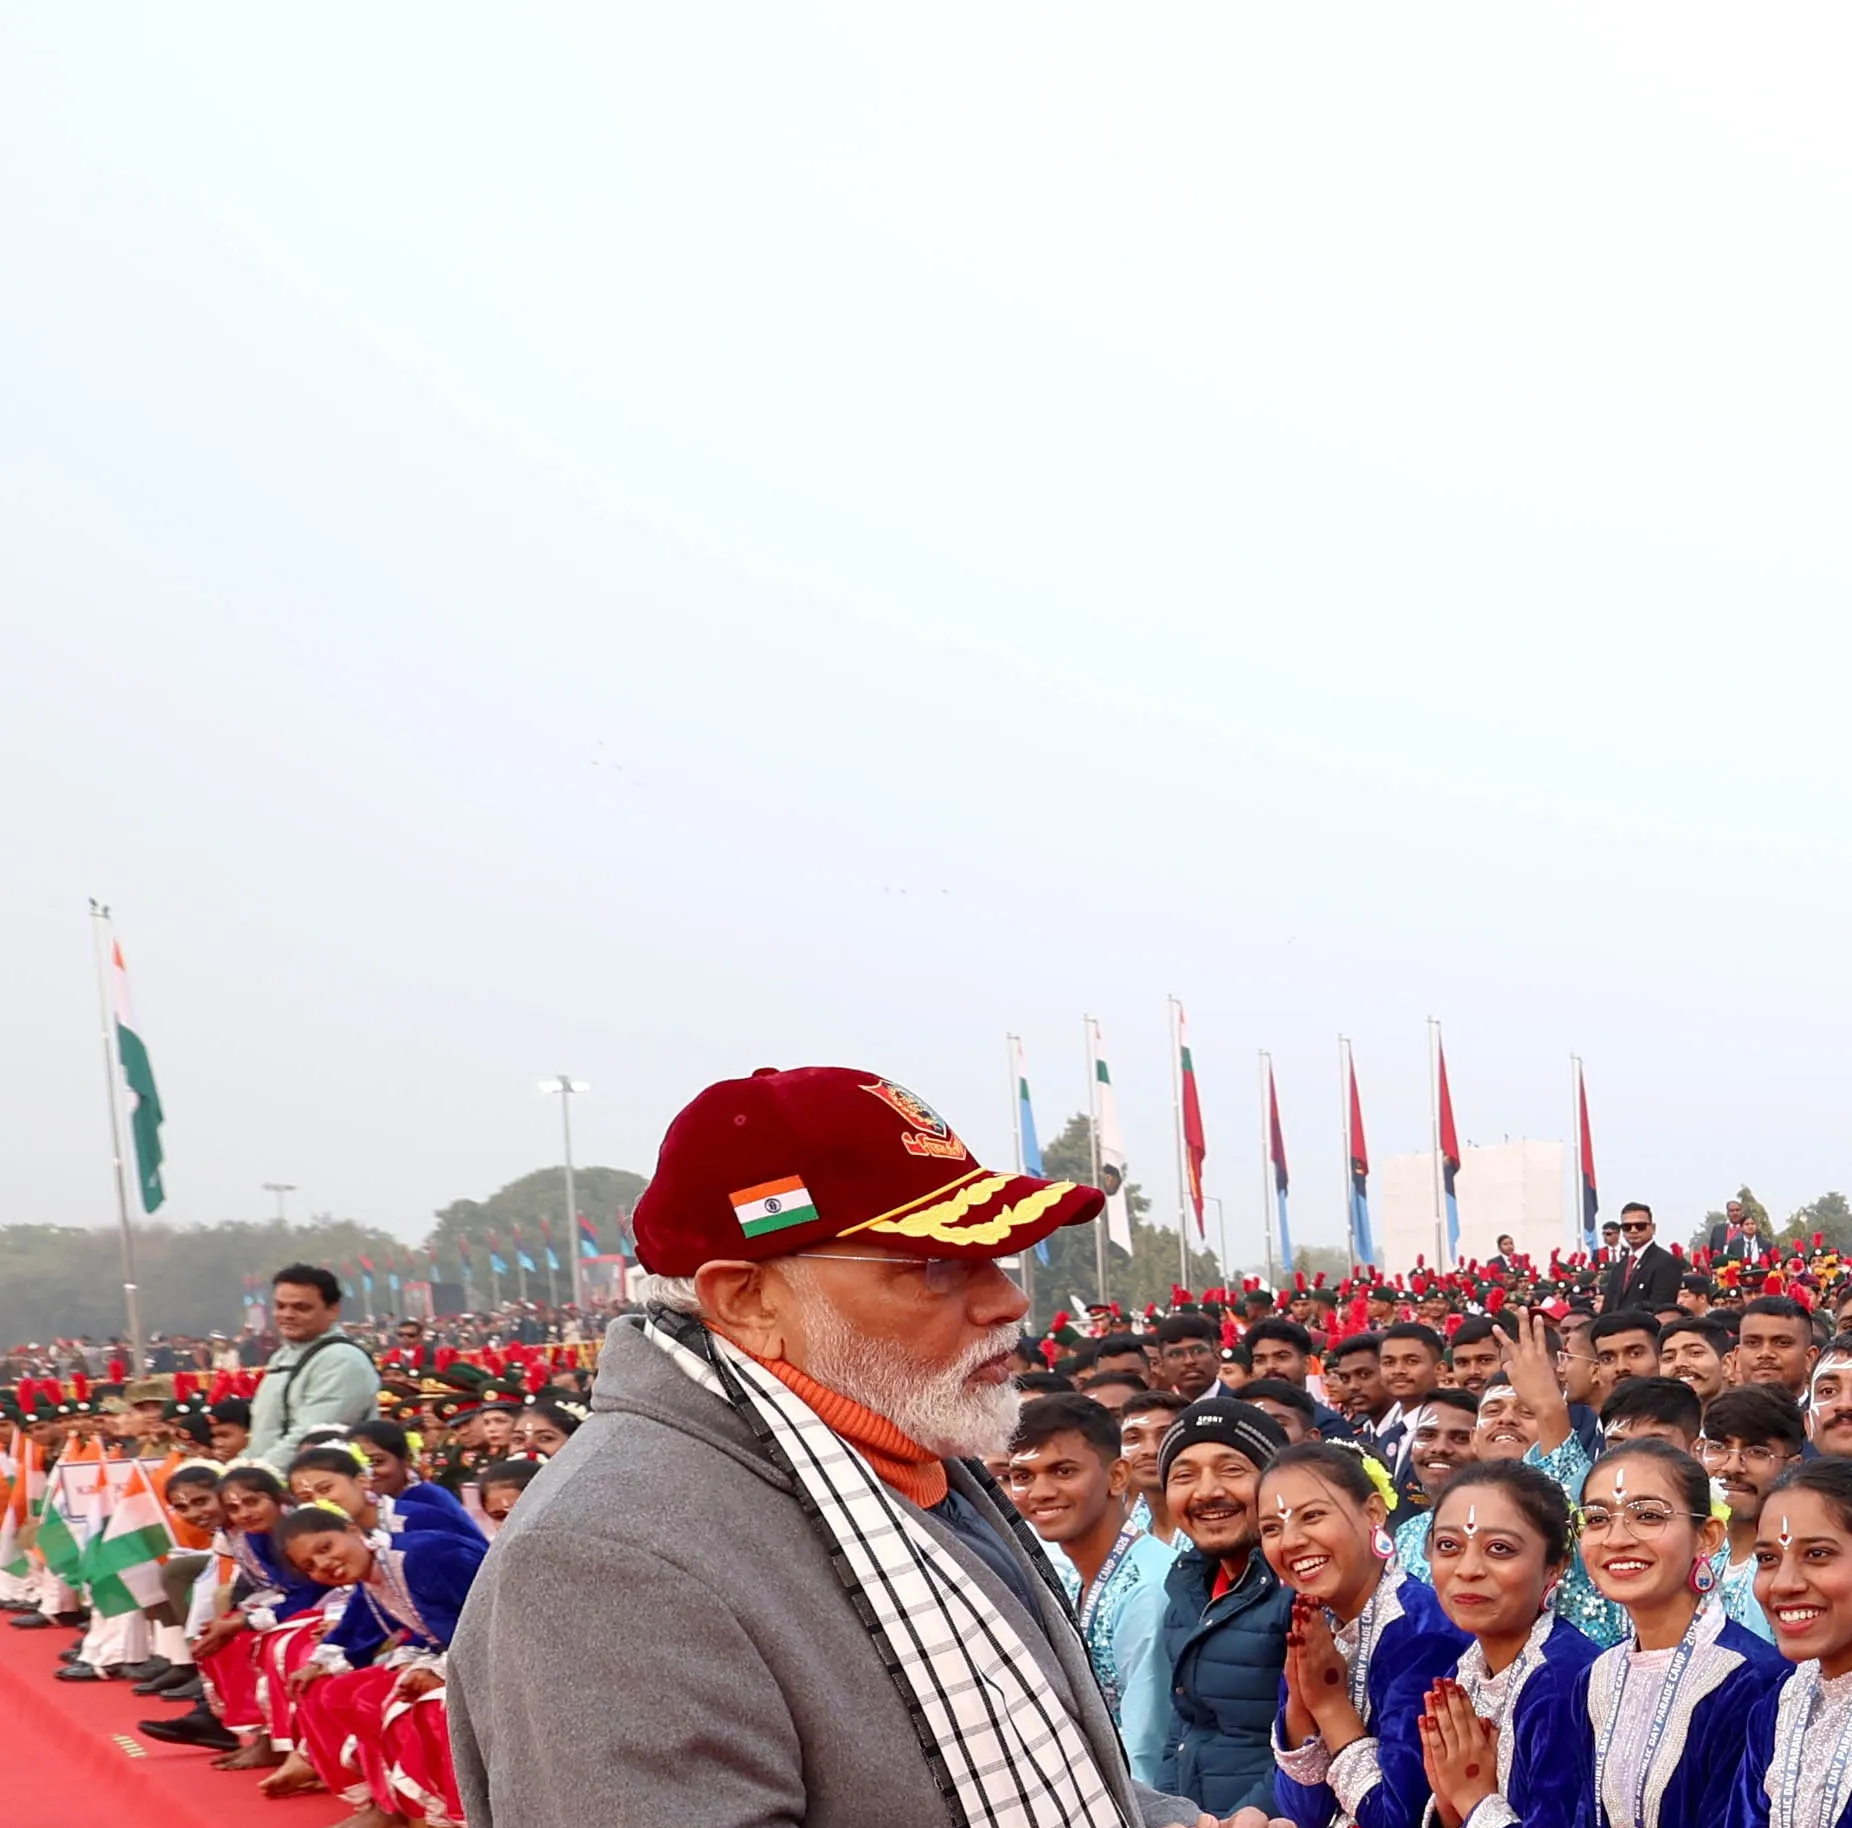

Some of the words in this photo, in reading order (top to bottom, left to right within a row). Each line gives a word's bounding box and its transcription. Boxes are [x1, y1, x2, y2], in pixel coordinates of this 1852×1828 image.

[1098, 1559, 1116, 1581] CAMP
[1361, 1597, 1374, 1624] CAM
[1359, 1624, 1372, 1660] PARADE
[1355, 1662, 1367, 1681] DAY
[1649, 1722, 1661, 1749] DAY
[1656, 1681, 1676, 1725] PARADE
[1669, 1651, 1687, 1684] CAMP
[1790, 1723, 1804, 1774] PARADE
[1783, 1770, 1798, 1797] DAY
[1830, 1758, 1846, 1787] DAY
